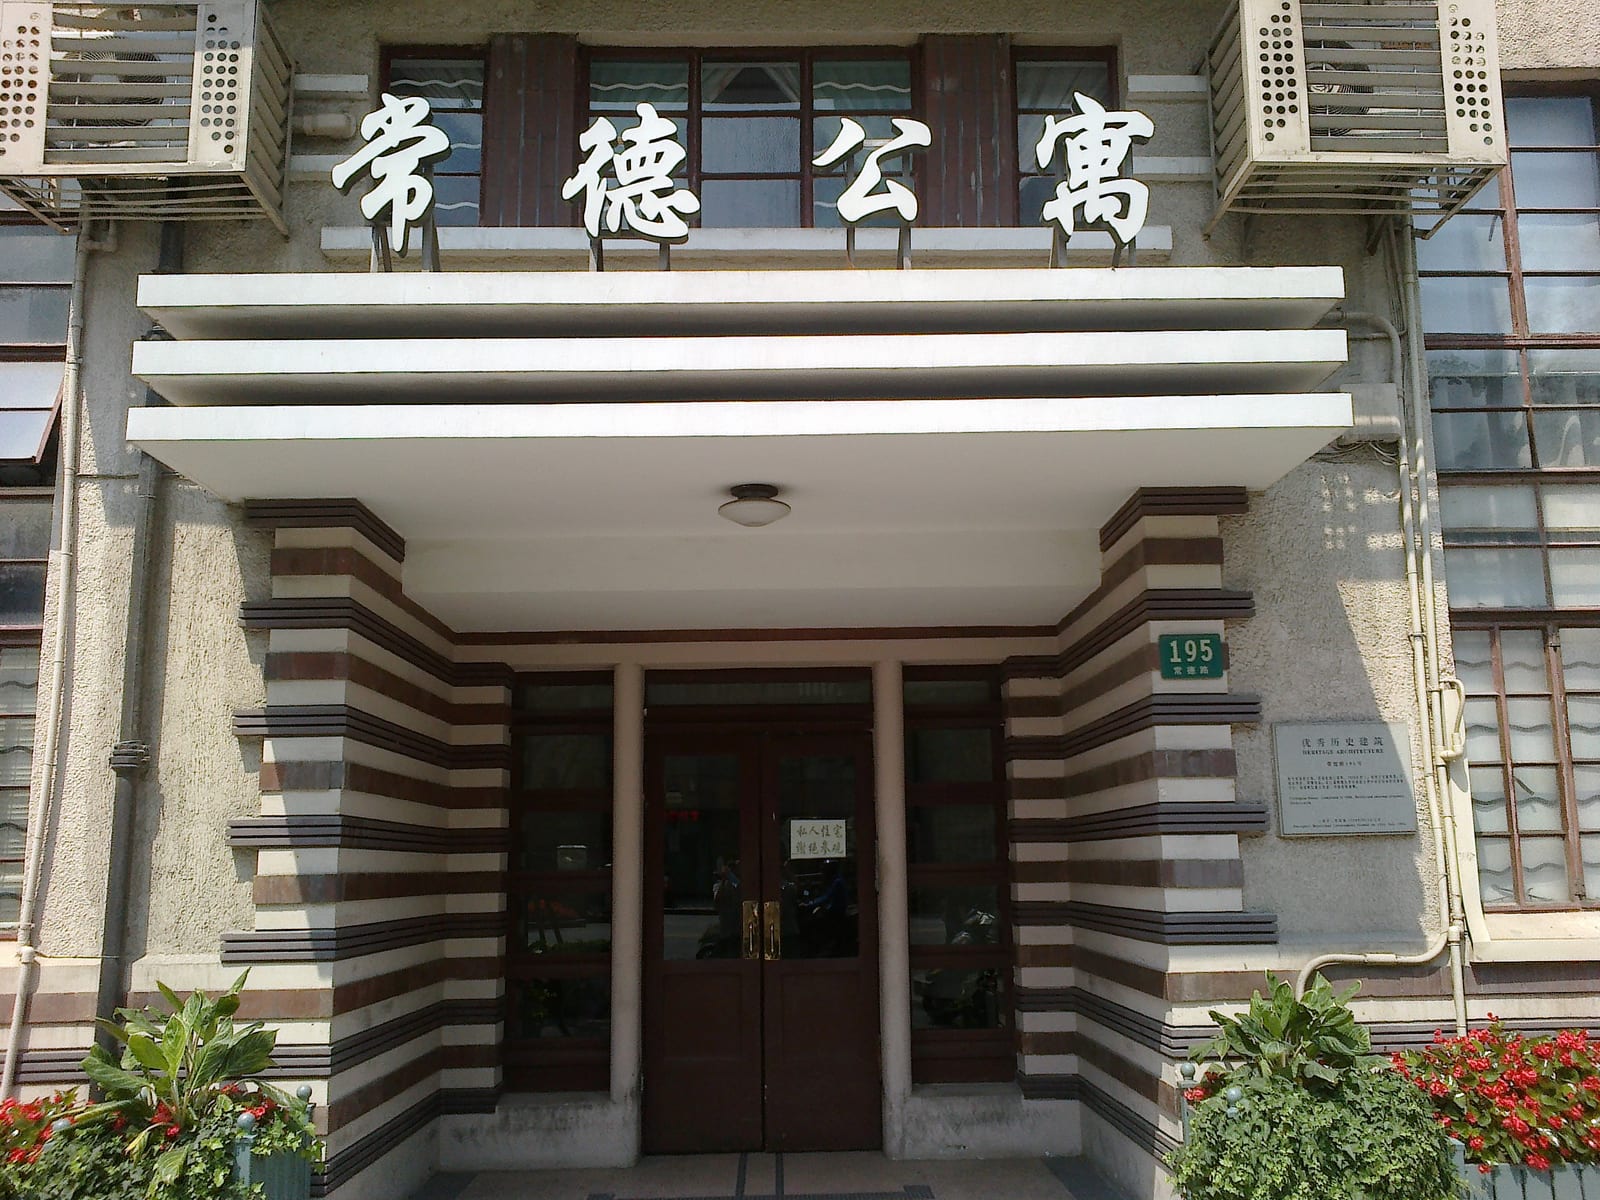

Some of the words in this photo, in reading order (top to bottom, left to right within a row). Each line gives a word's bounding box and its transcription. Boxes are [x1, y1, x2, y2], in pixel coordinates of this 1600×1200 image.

[331, 91, 1155, 253] 常德公寓
[1169, 639, 1213, 663] 195
[1302, 736, 1384, 748] 优秀历史建筑
[796, 823, 843, 838] 私人住宅
